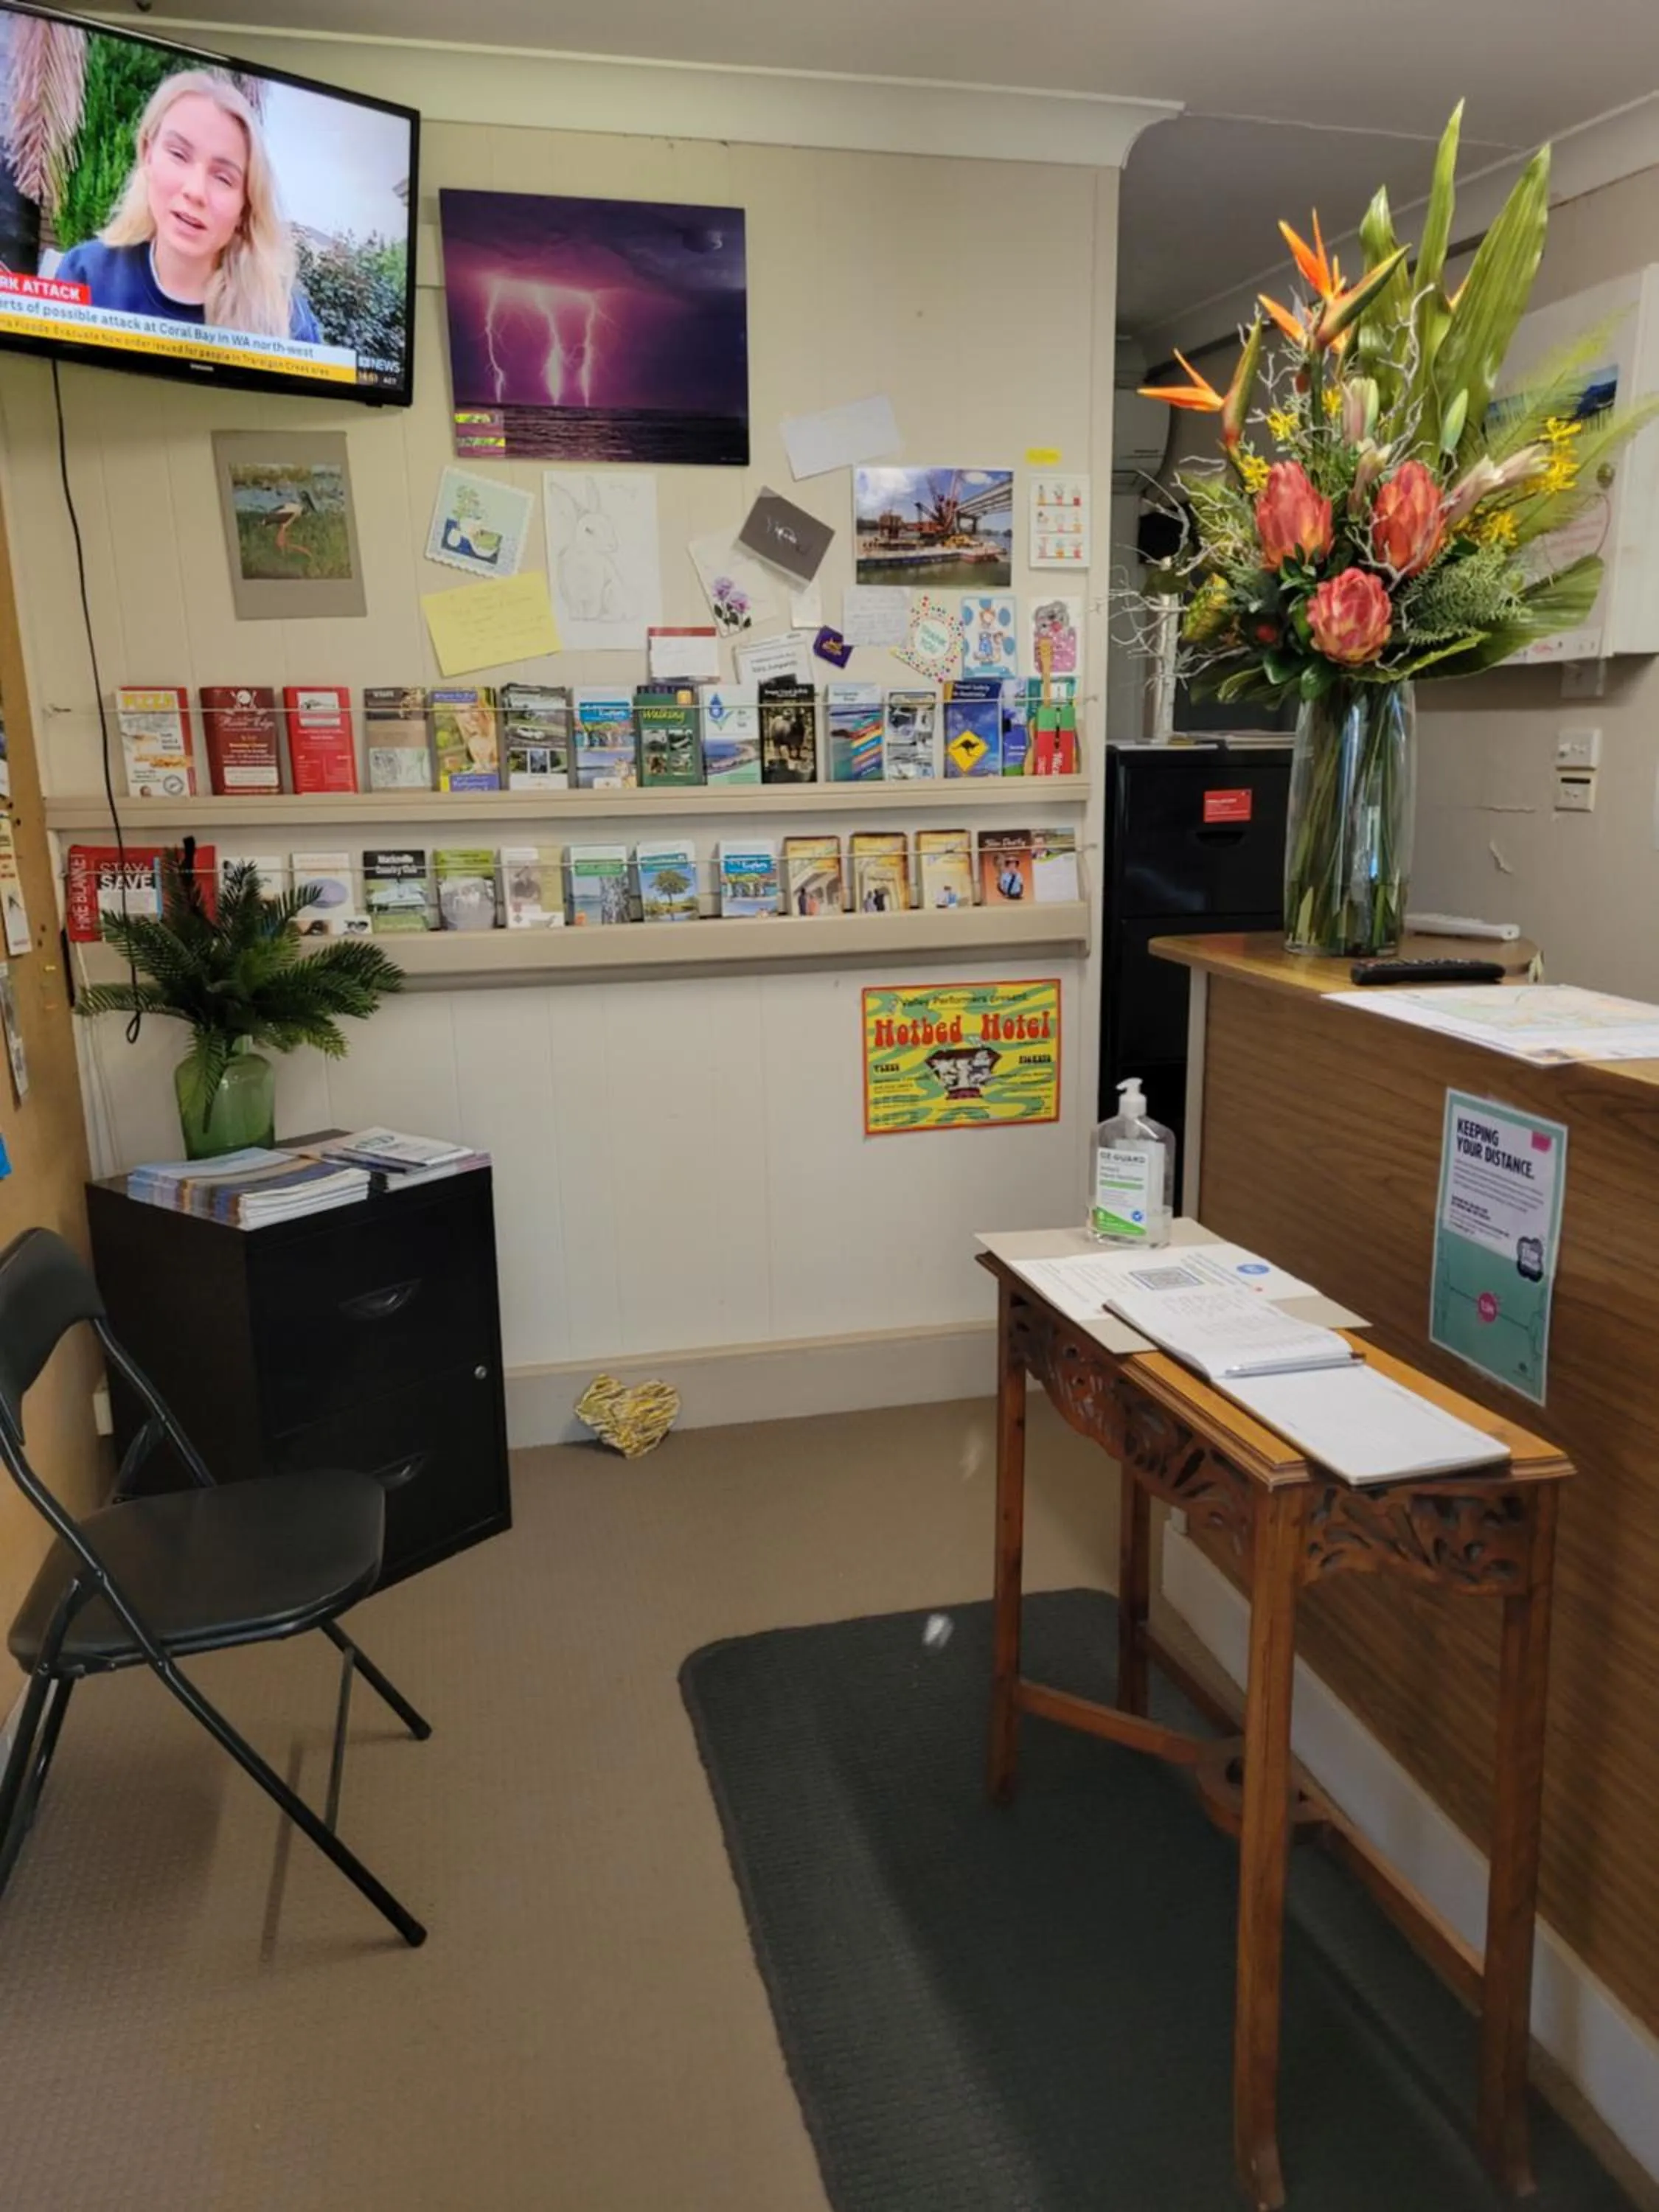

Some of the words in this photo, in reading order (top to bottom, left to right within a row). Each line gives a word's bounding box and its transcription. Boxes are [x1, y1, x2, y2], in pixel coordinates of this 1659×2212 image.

[23, 279, 80, 302] ATTACK
[27, 302, 39, 315] of
[43, 304, 98, 324] possible
[101, 313, 141, 330] attack
[144, 320, 156, 333] at
[159, 321, 193, 338] Coral
[195, 328, 215, 344] Bay
[218, 333, 229, 344] in
[232, 334, 251, 347] WA
[253, 338, 314, 358] north-west
[100, 874, 153, 890] SAVE
[874, 1015, 963, 1048] Hotbed
[980, 1010, 1051, 1041] Hotel
[1457, 1117, 1500, 1147] KEEPING
[1457, 1135, 1483, 1160] YOUR
[1484, 1144, 1535, 1180] DISTANCE.
